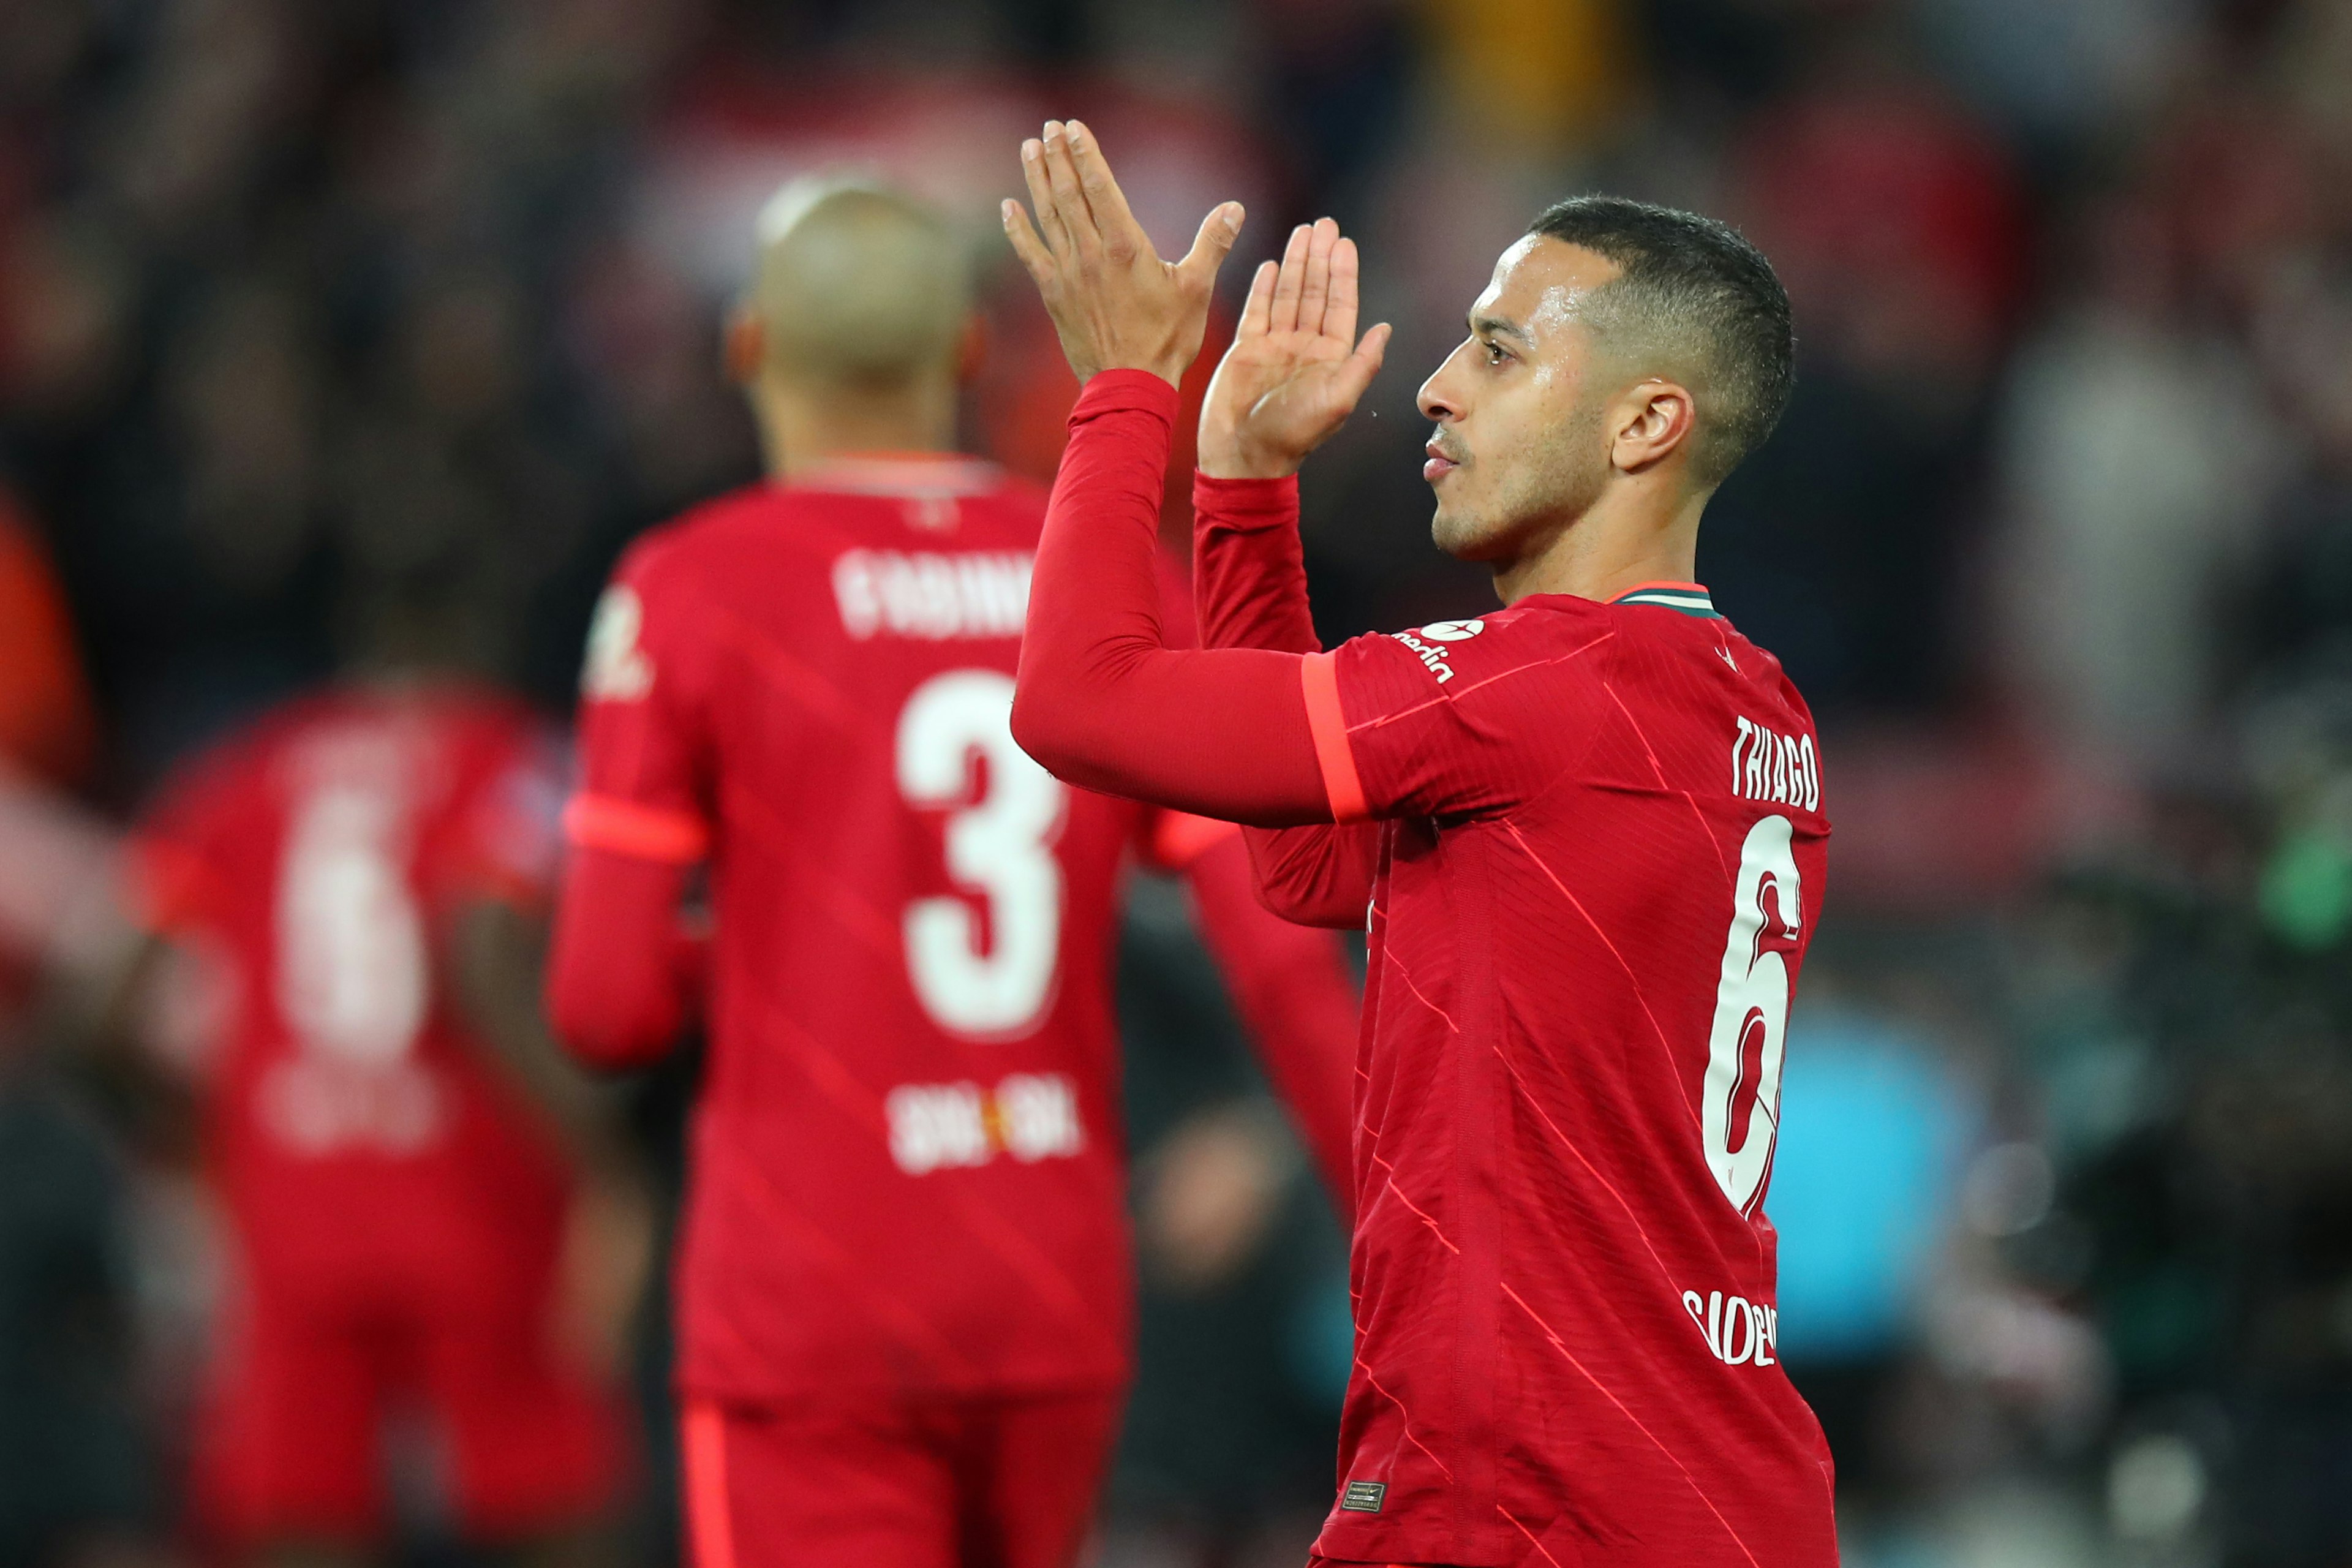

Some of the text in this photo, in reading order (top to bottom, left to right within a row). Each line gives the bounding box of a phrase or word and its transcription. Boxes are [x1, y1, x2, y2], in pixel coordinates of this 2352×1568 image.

[897, 671, 1065, 1039] 3
[1732, 715, 1820, 813] THIAGO
[1702, 815, 1801, 1221] 6
